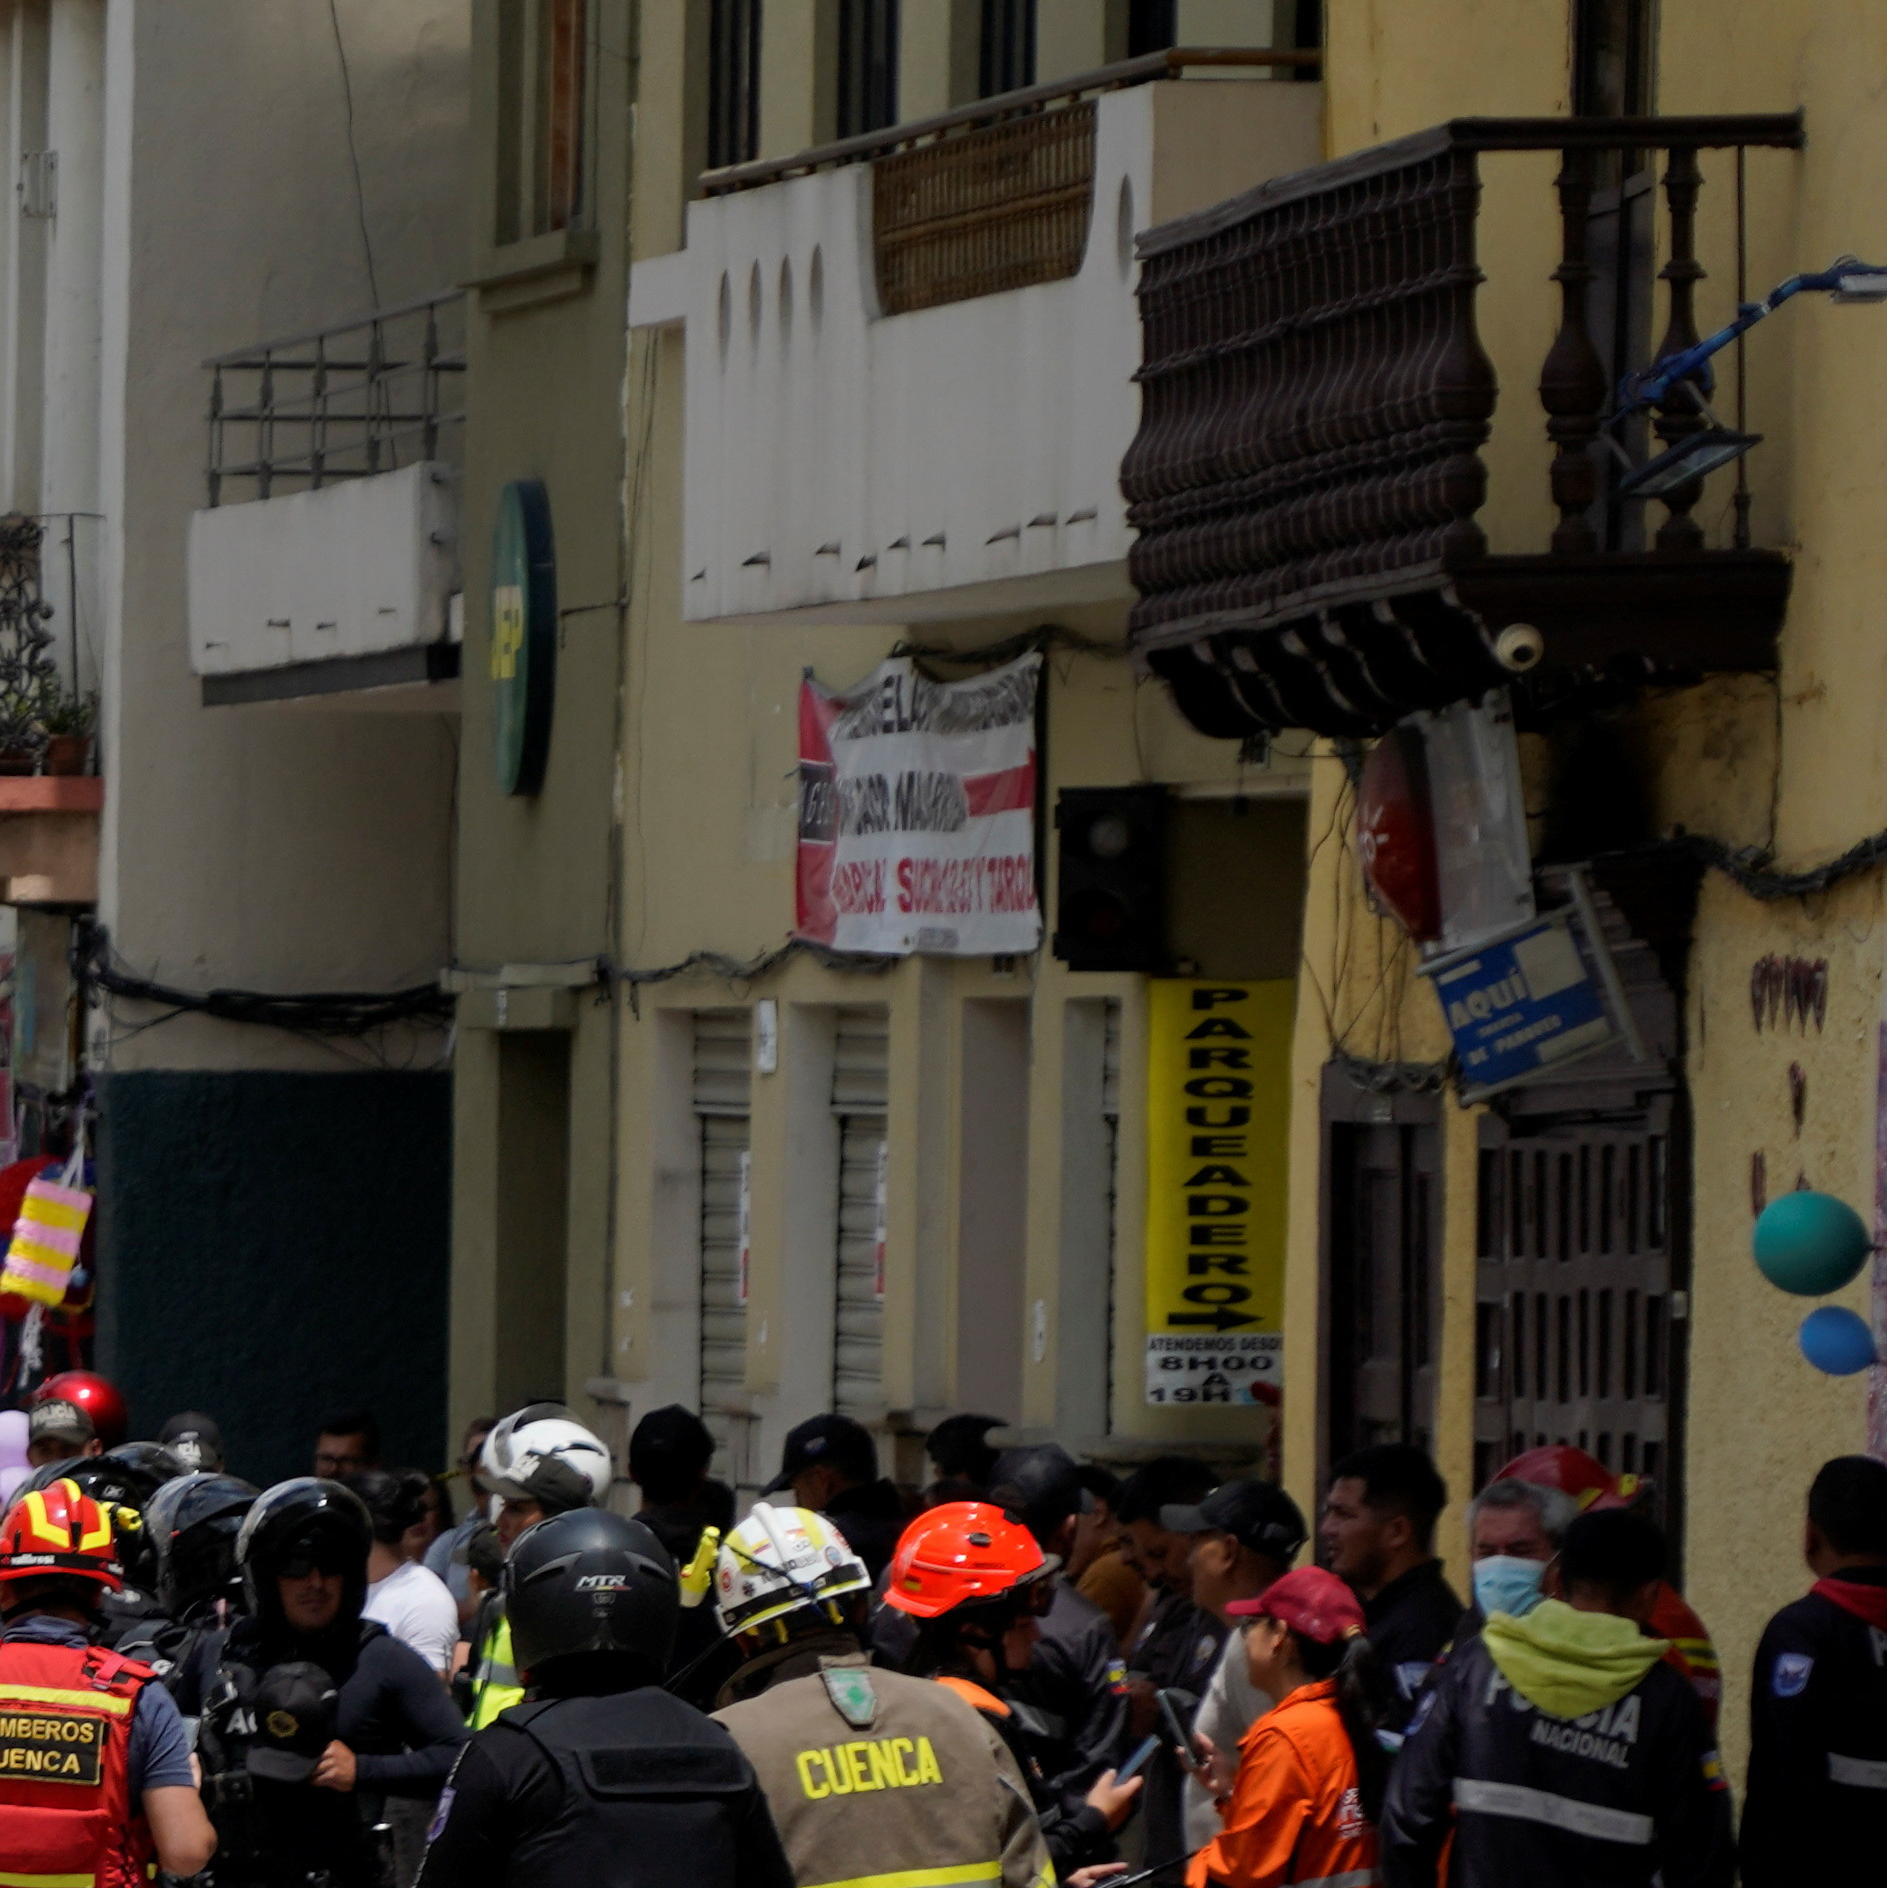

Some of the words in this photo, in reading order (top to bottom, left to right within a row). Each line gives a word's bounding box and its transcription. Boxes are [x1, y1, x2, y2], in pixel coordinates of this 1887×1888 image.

[1183, 988, 1255, 1306] PARQUEADERO
[1159, 1355, 1273, 1371] 8H00
[796, 1736, 944, 1800] CUENCA
[1529, 1718, 1631, 1769] NACIONAL
